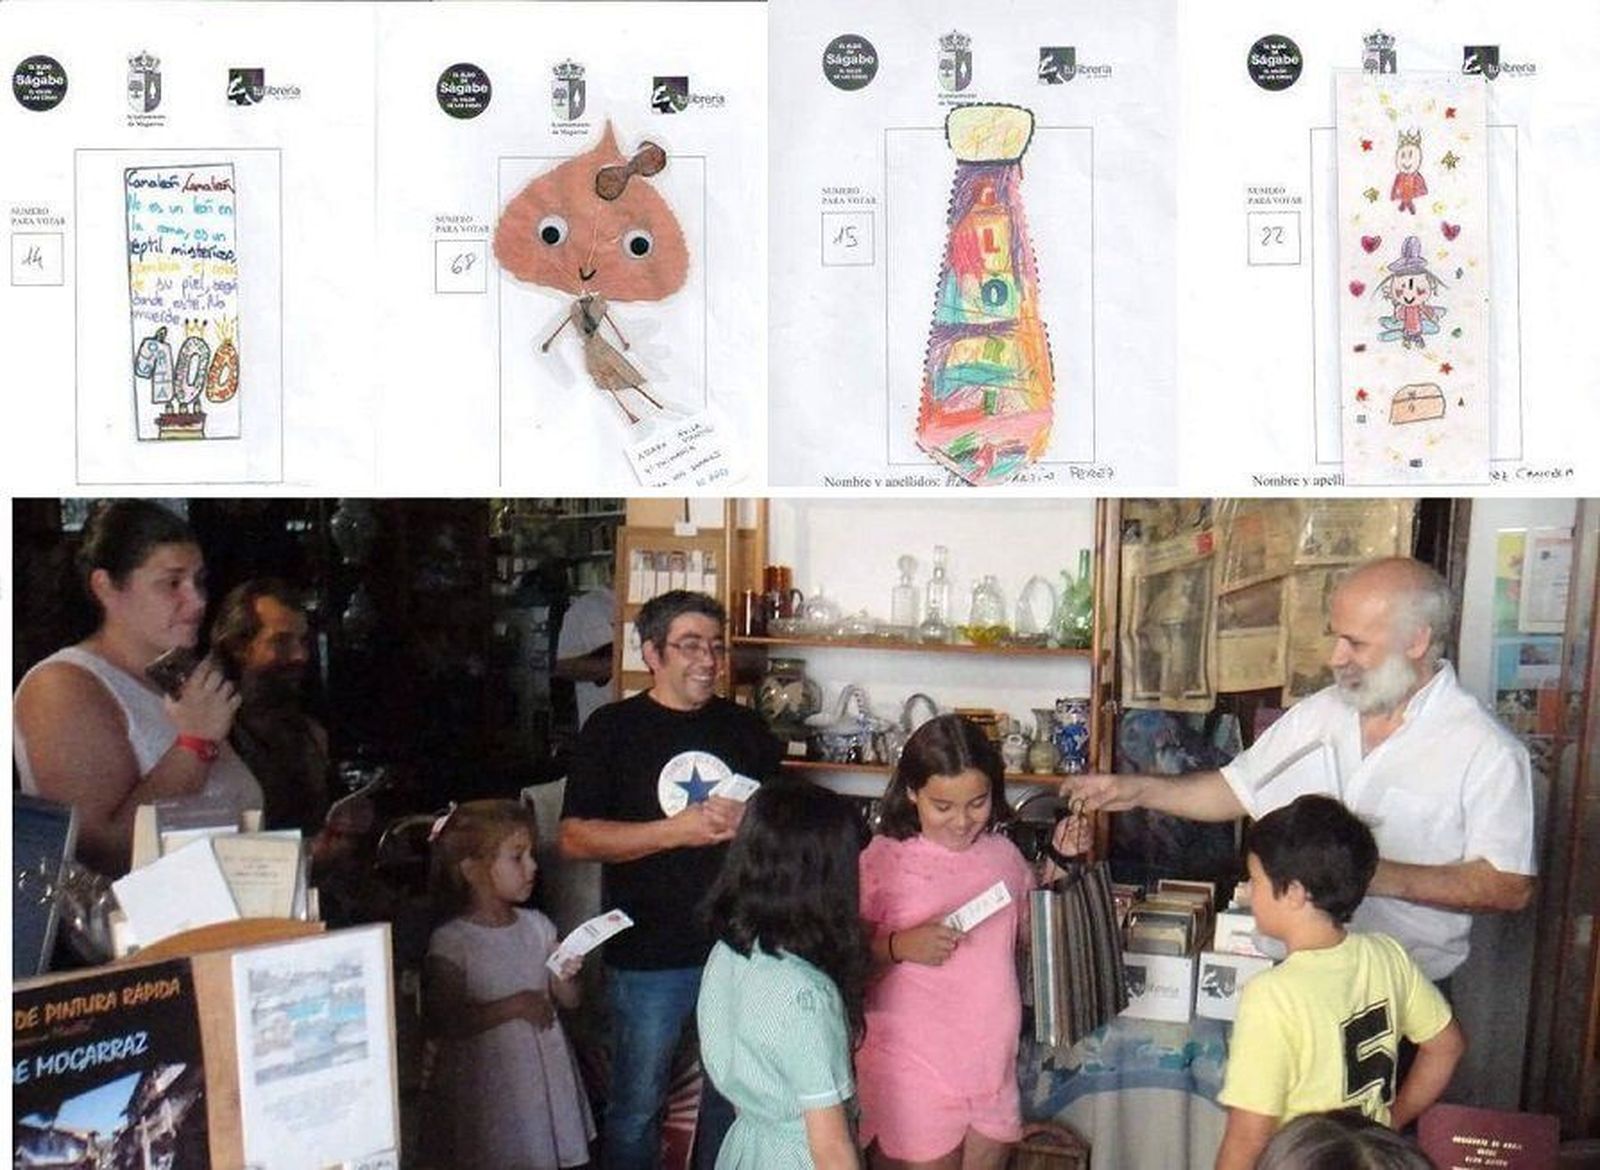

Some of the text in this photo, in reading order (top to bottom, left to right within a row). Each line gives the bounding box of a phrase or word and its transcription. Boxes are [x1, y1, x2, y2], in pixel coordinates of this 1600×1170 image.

[822, 197, 877, 205] PARA VOTAR
[1248, 197, 1302, 205] PARA VOTAR
[12, 217, 66, 225] PARA VOTAR
[436, 225, 489, 233] PARA VOTAR
[832, 226, 858, 248] 15
[824, 475, 872, 488] Nombre
[1252, 474, 1300, 488] Nombre
[14, 977, 181, 1031] DE PINTURA RÁPIDA
[13, 1058, 30, 1085] E
